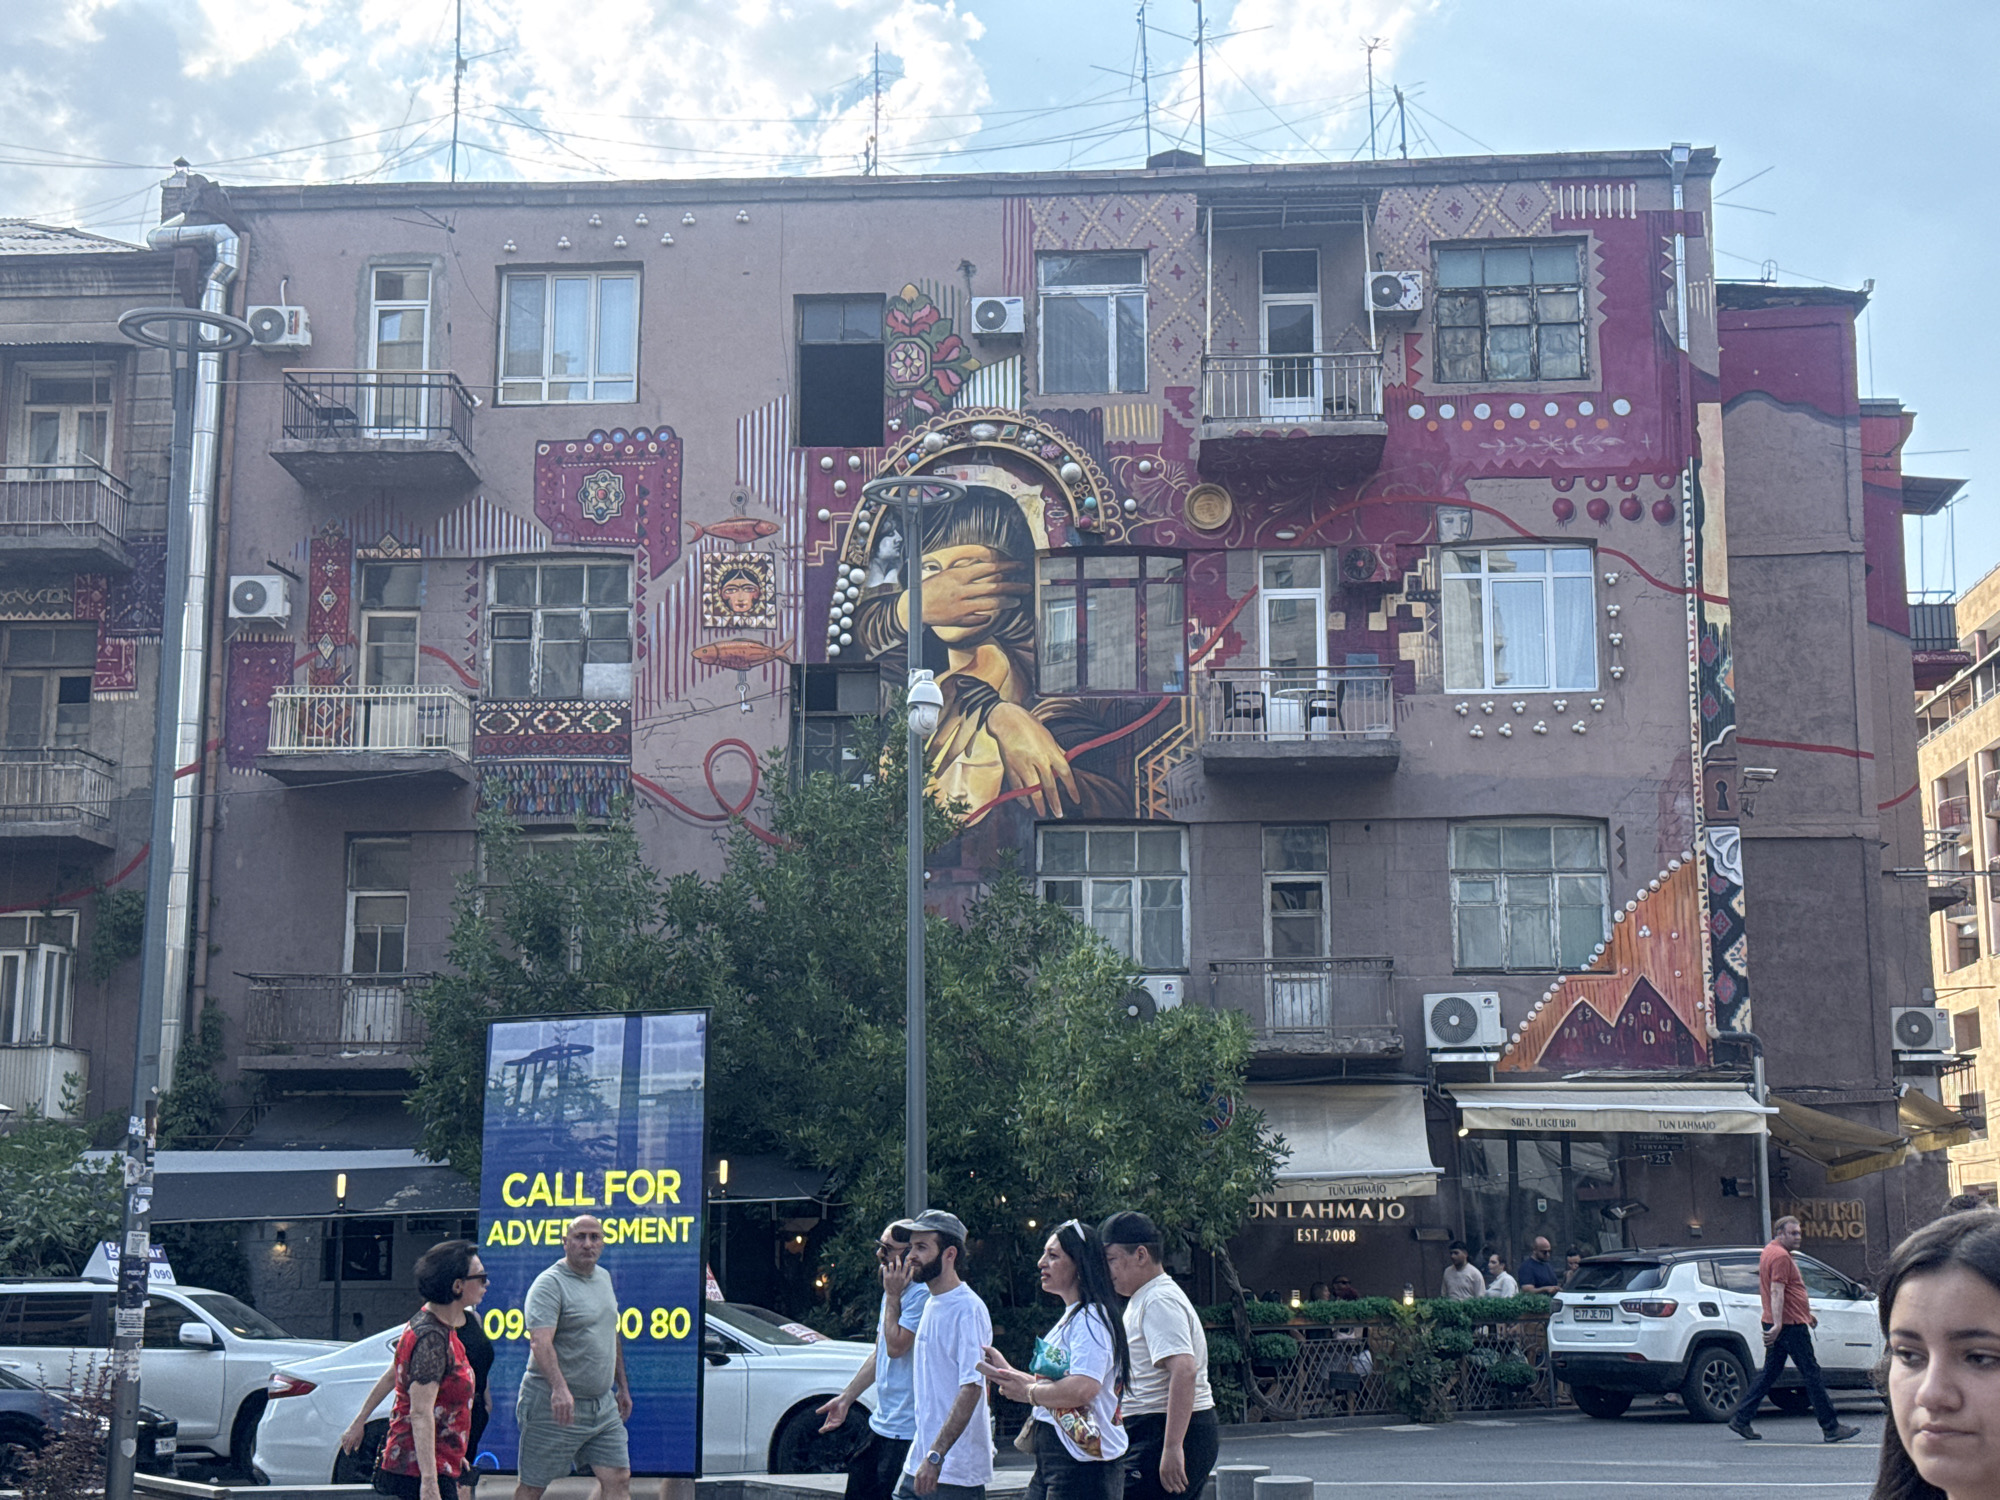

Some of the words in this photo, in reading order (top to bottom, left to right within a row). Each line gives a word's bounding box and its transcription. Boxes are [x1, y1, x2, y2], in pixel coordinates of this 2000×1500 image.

[1658, 1119, 1676, 1130] TUN
[1677, 1120, 1716, 1132] LAHMAJO
[1655, 1154, 1666, 1164] 25
[502, 1171, 596, 1208] CALL
[604, 1169, 682, 1206] FOR
[1328, 1186, 1346, 1197] TUN
[1347, 1184, 1387, 1196] LAHMAJO
[1249, 1202, 1277, 1218] UN
[1287, 1202, 1406, 1222] LAHMAJO
[486, 1216, 695, 1246] ADVESMENT
[153, 1268, 172, 1280] 090
[650, 1307, 691, 1339] 80
